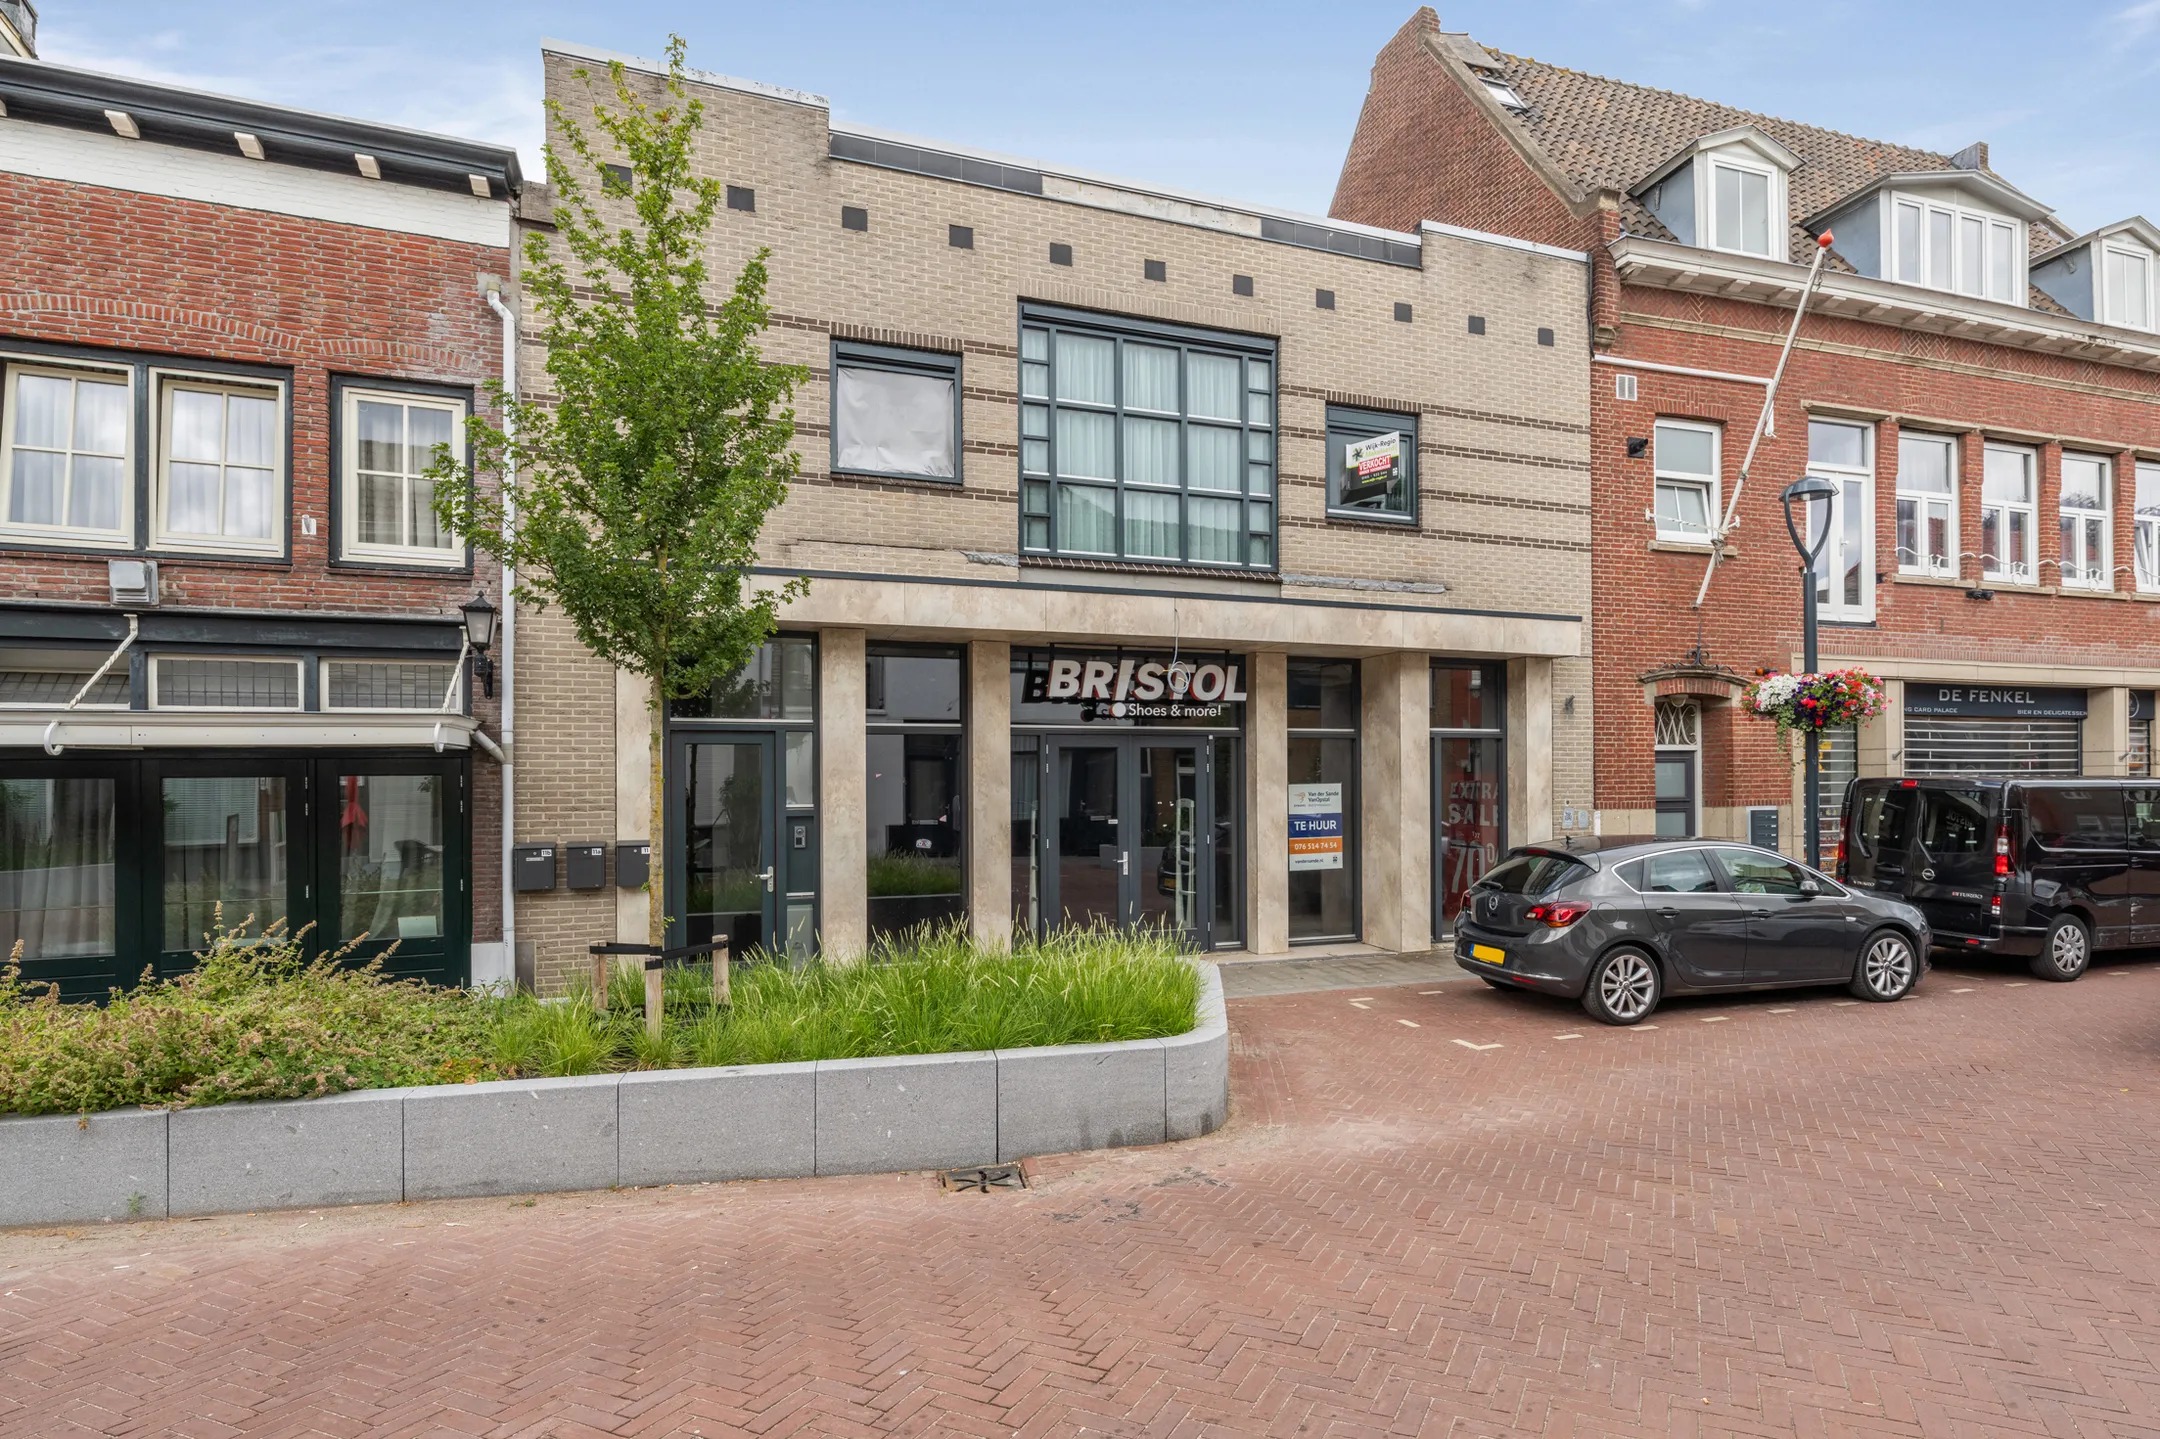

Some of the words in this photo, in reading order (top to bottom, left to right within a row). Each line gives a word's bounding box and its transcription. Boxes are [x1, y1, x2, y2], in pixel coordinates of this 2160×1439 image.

[1365, 438, 1396, 450] Wijk-Regio
[1360, 457, 1390, 471] VERKOCHT
[1046, 659, 1247, 701] BRISTOL
[1938, 689, 1962, 702] DE
[1969, 690, 2035, 704] FENKEL
[1128, 703, 1167, 717] Shoes
[1170, 705, 1181, 717] &
[1184, 704, 1222, 717] more!
[1448, 803, 1498, 826] SALE
[1294, 821, 1307, 831] TE
[1309, 820, 1337, 831] HUUR
